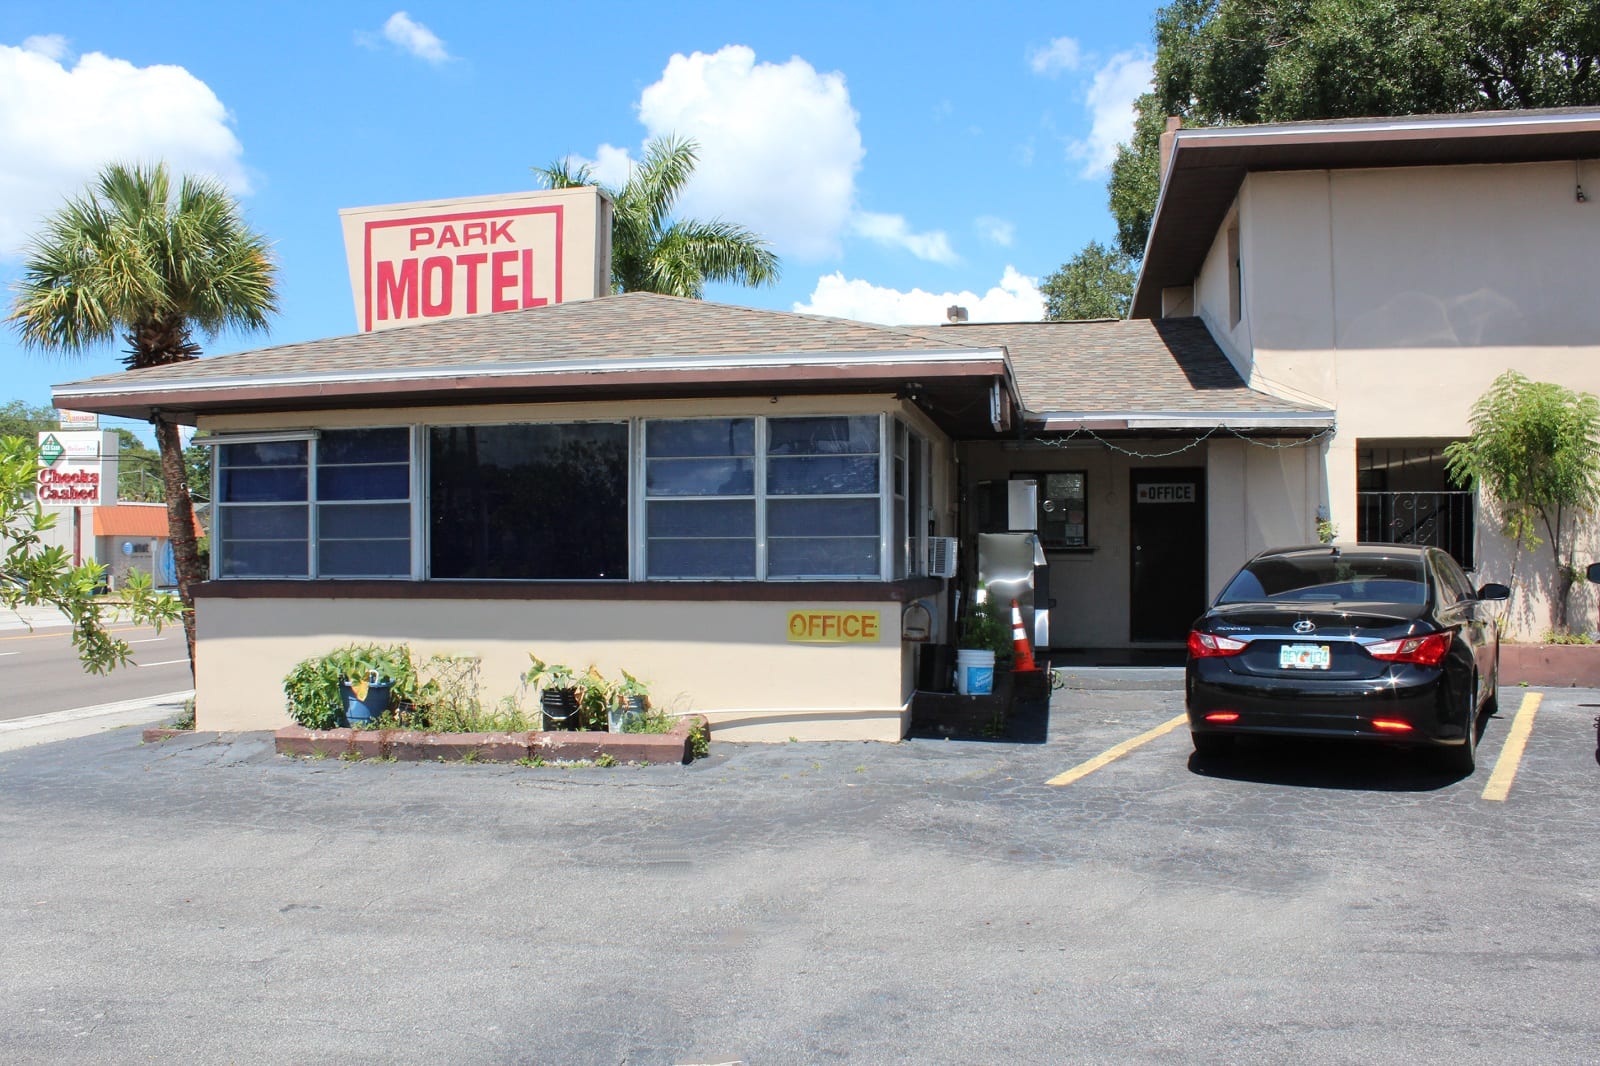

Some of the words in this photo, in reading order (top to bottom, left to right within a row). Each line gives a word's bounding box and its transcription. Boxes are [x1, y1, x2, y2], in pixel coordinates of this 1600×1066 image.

[410, 219, 516, 251] PARK
[377, 248, 548, 321] MOTEL
[40, 469, 99, 483] Checks
[39, 485, 99, 499] Cashed
[1148, 486, 1192, 500] OFFICE
[789, 613, 876, 637] OFFICE
